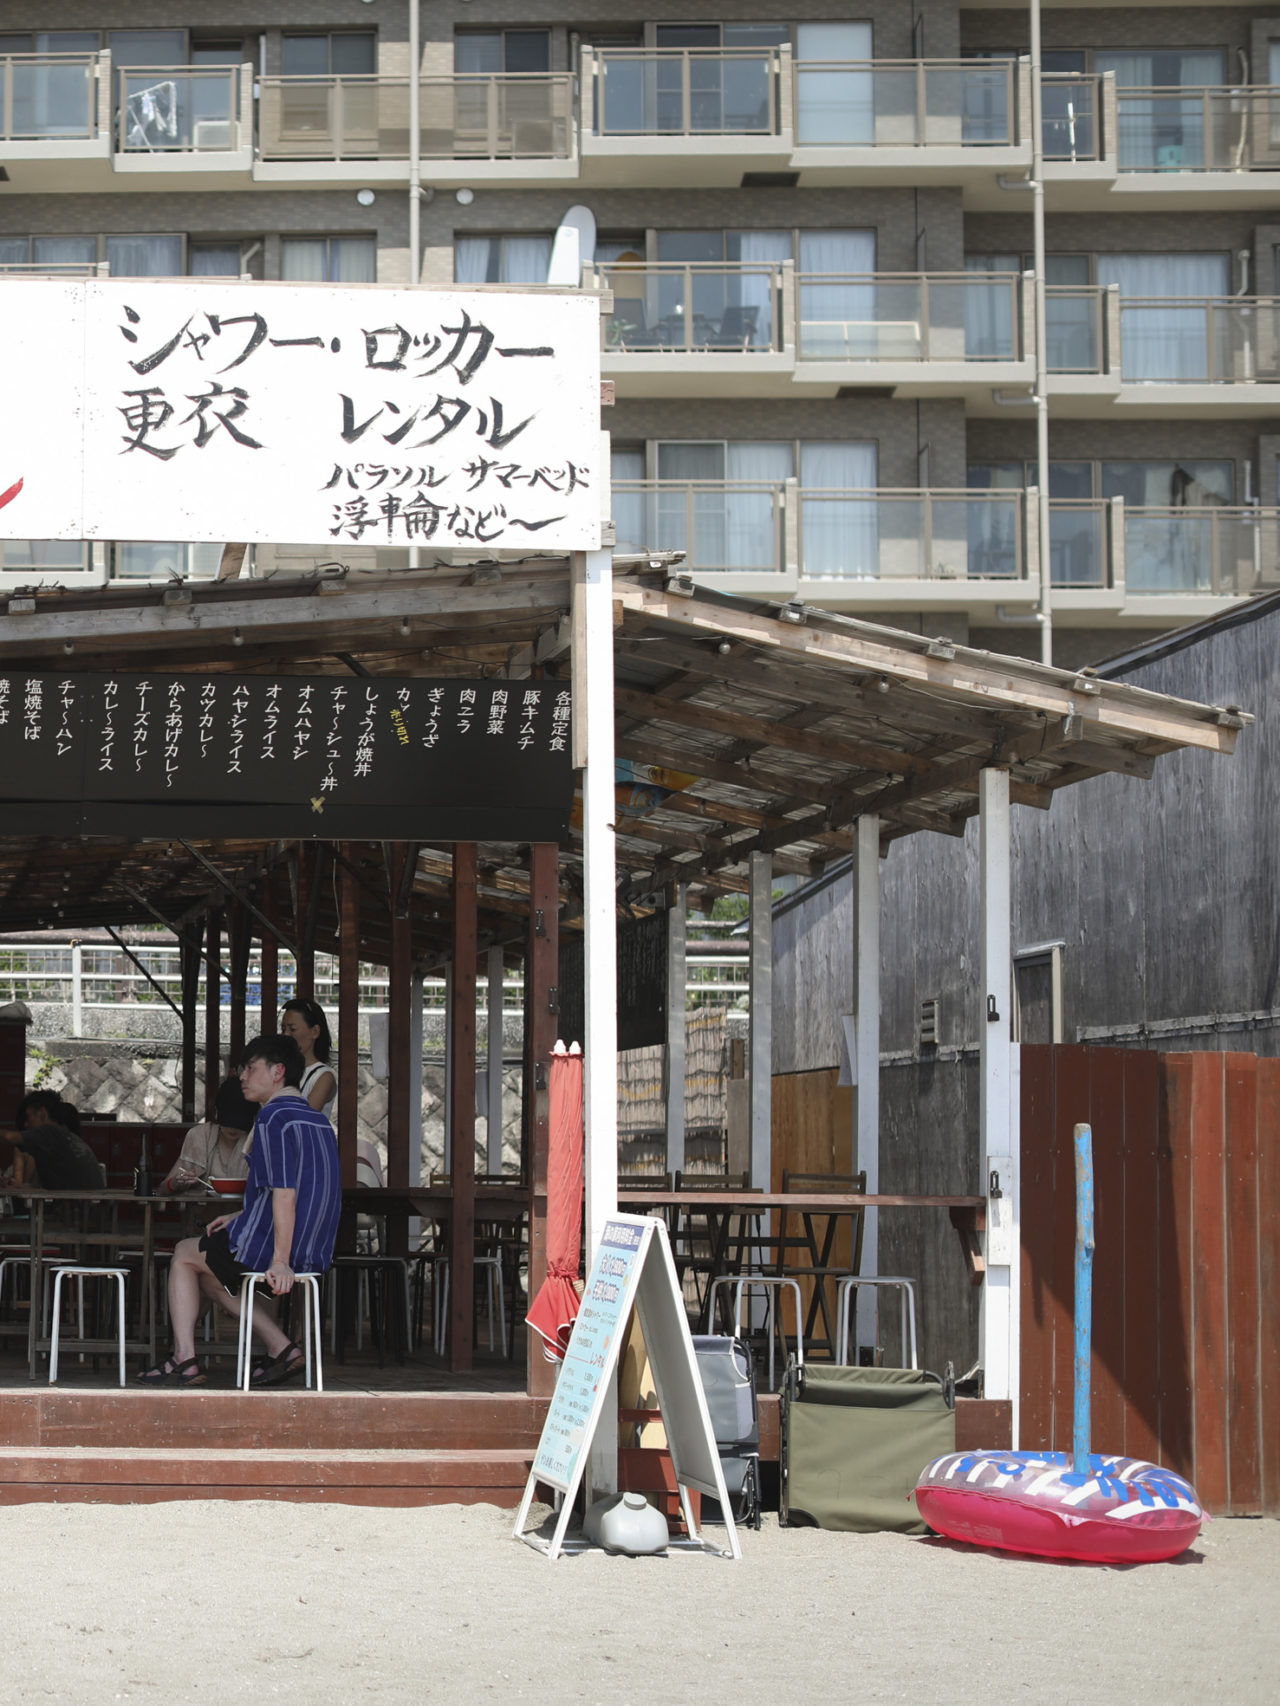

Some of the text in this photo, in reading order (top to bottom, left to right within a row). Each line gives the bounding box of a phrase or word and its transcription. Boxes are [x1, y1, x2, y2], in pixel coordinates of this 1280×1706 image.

[118, 382, 544, 461] 更衣 レンタル
[319, 457, 590, 496] パラソル サマーベッド
[24, 679, 43, 740] 塩焼そば
[227, 685, 250, 774] ハヤシライス
[260, 685, 282, 759] オムライス
[292, 685, 314, 760] オムハヤシ
[353, 687, 379, 777] しょうが焼丼
[422, 688, 444, 748] ぎょうざ
[487, 690, 508, 734] 肉野菜
[518, 690, 541, 750] 豚キムチ
[549, 691, 572, 751] 各種定食
